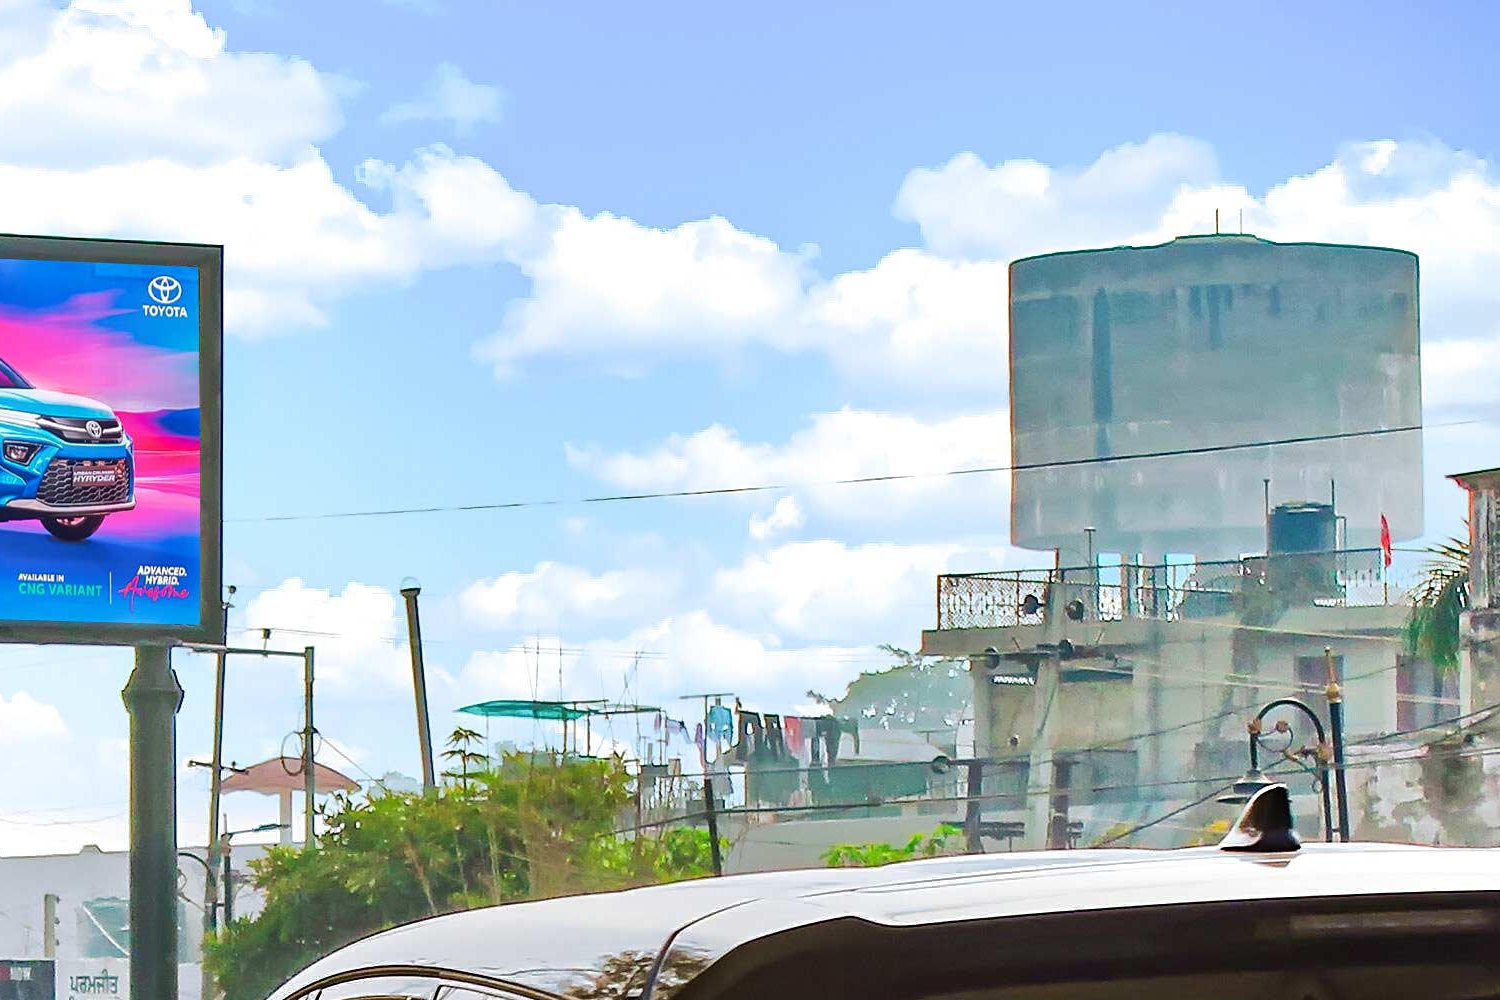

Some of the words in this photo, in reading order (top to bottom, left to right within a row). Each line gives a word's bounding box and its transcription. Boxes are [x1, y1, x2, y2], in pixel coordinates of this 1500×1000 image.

[142, 304, 188, 318] TOYOTA
[73, 475, 115, 483] HYRYDER
[136, 565, 188, 577] ADVANCED.
[18, 573, 55, 582] AVAILABLE
[56, 574, 65, 583] IN
[145, 575, 180, 586] HYBRID.
[18, 582, 45, 596] CNG
[49, 584, 102, 597] VARIANT
